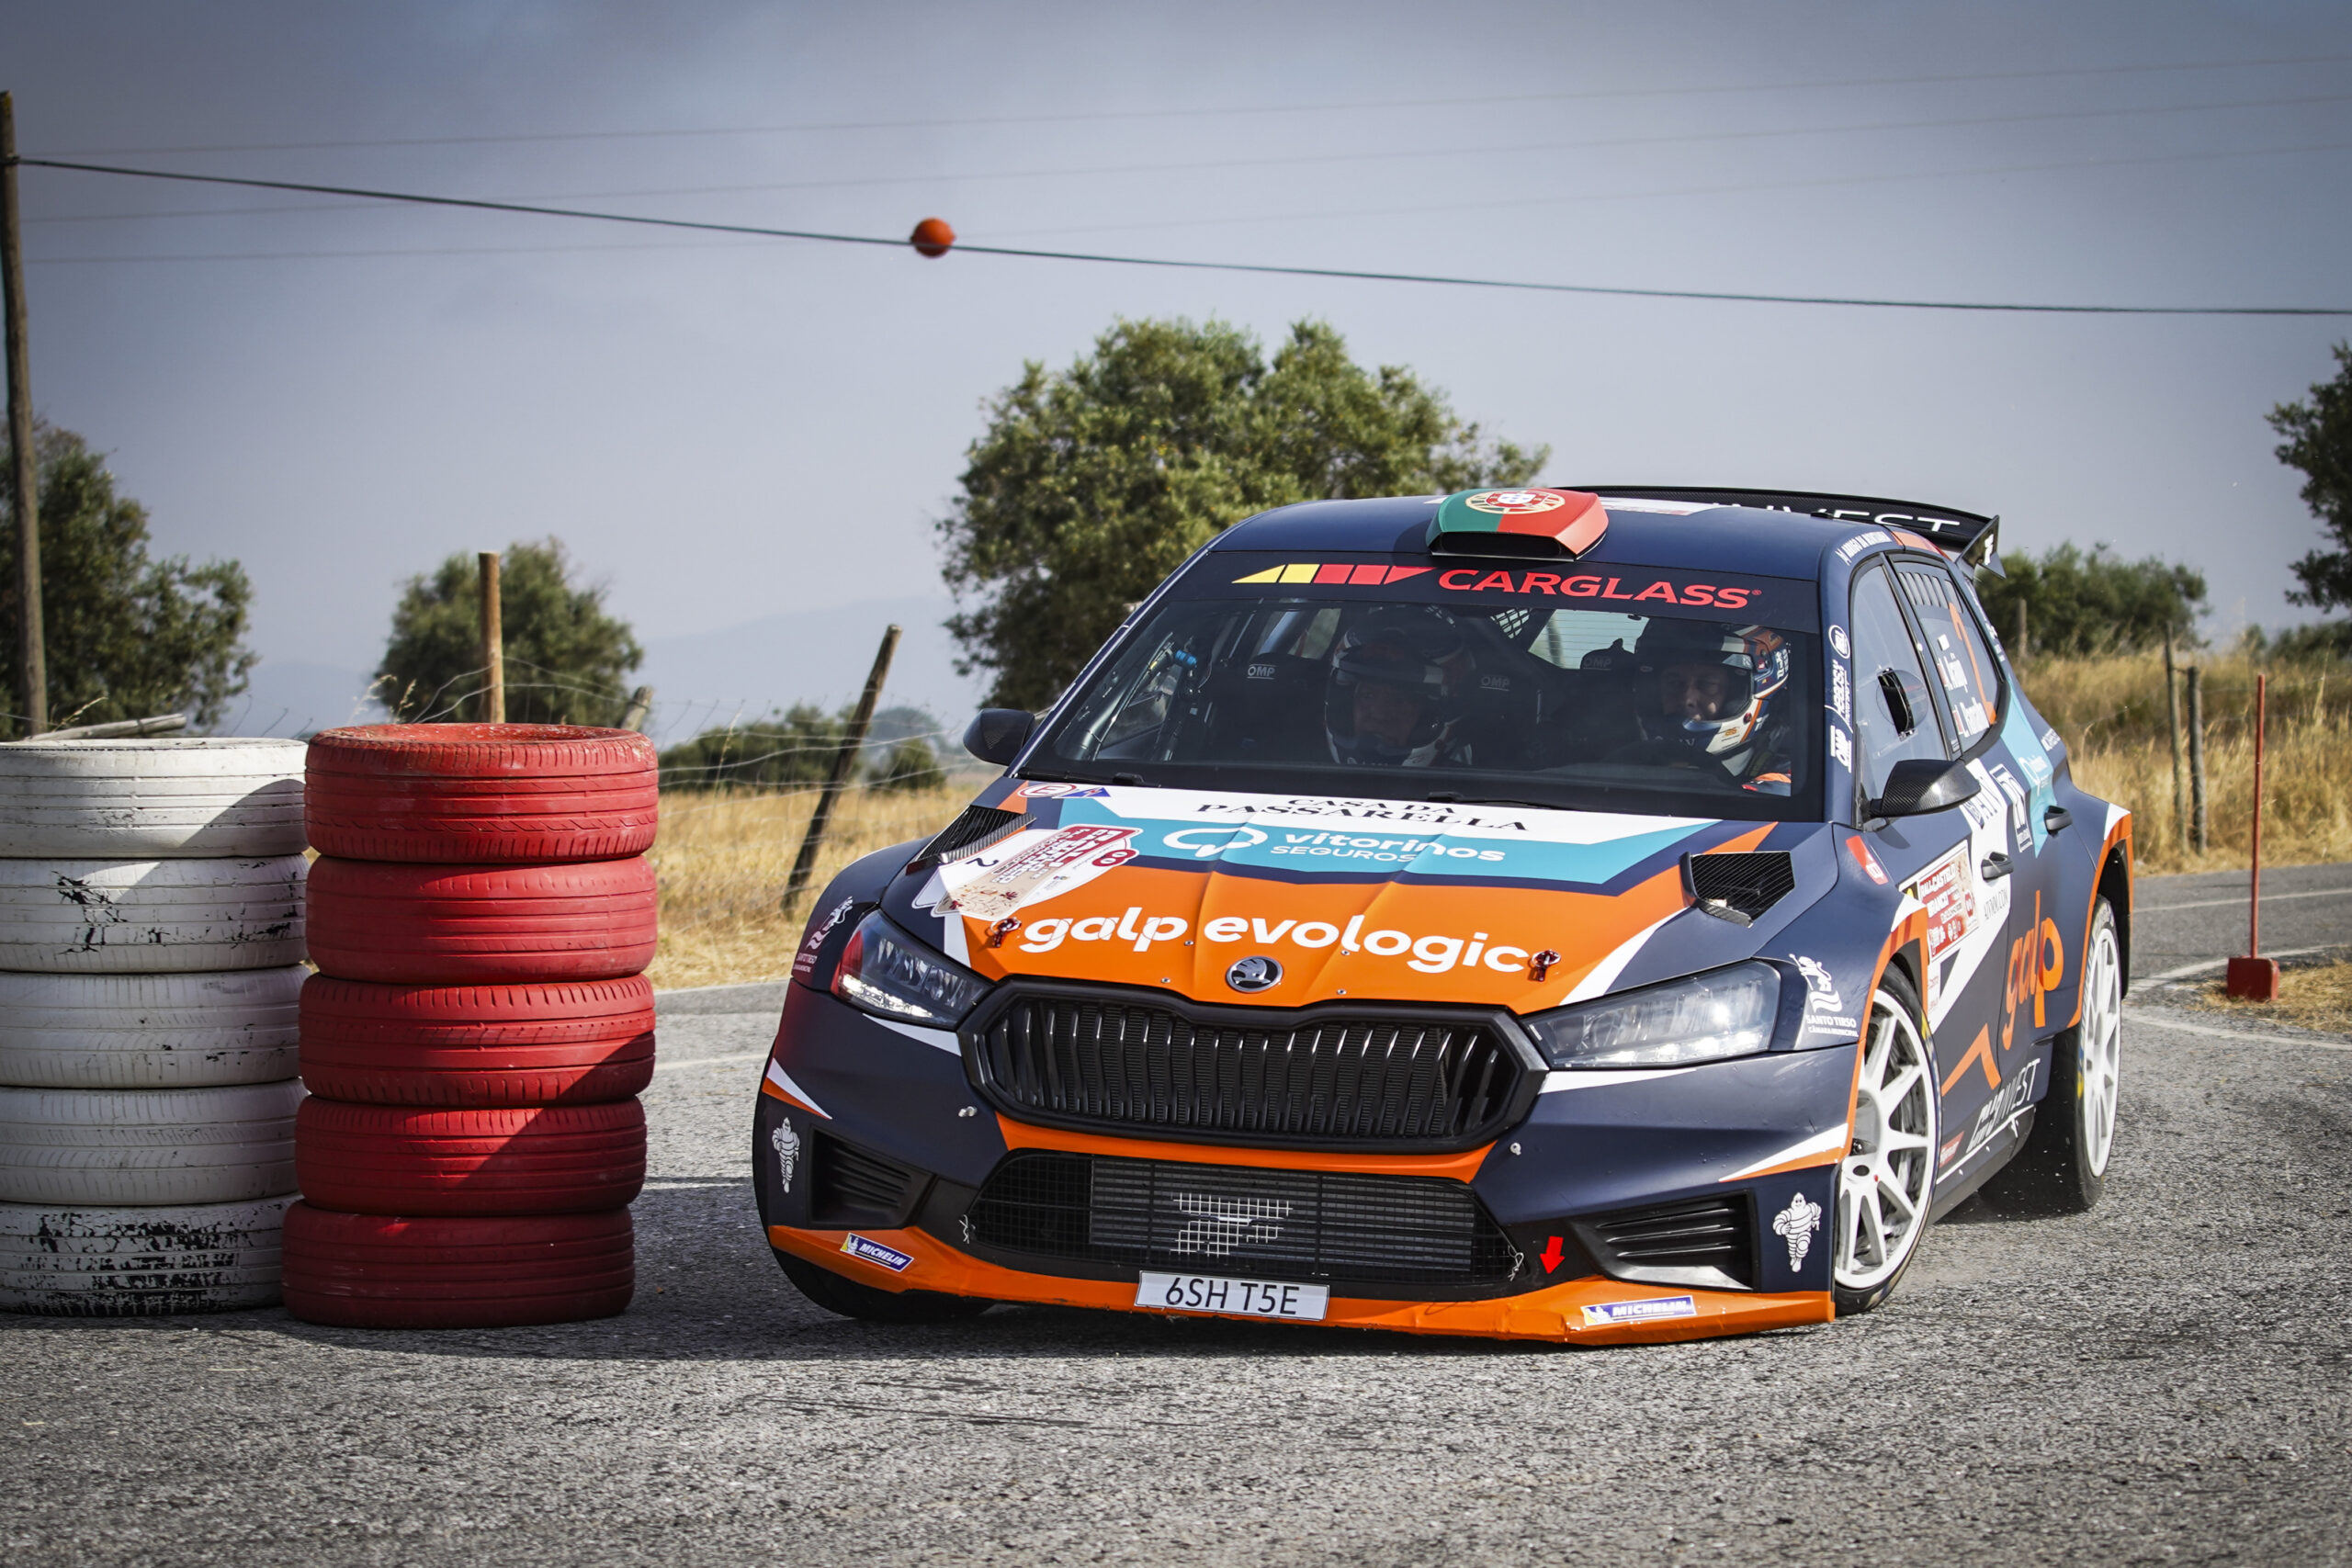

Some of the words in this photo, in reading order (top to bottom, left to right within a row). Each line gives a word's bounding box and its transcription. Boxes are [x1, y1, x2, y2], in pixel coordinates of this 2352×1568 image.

[1247, 665, 1276, 678] OMP
[1194, 803, 1530, 831] PASSARELLA
[1288, 798, 1387, 809] CASA
[1406, 804, 1456, 815] DA
[1271, 845, 1418, 863] SEGUROS
[1283, 830, 1507, 862] vitorinos
[1018, 907, 1188, 953] galp
[1204, 914, 1531, 975] evologic
[2002, 889, 2064, 1051] galp
[1805, 1015, 1834, 1025] SANTO
[1834, 1017, 1857, 1028] TIRSO
[858, 1243, 906, 1266] MICHELIN
[1166, 1278, 1227, 1309] 6SH
[1238, 1283, 1300, 1315] T5E
[1611, 1300, 1688, 1317] MICHELIN
